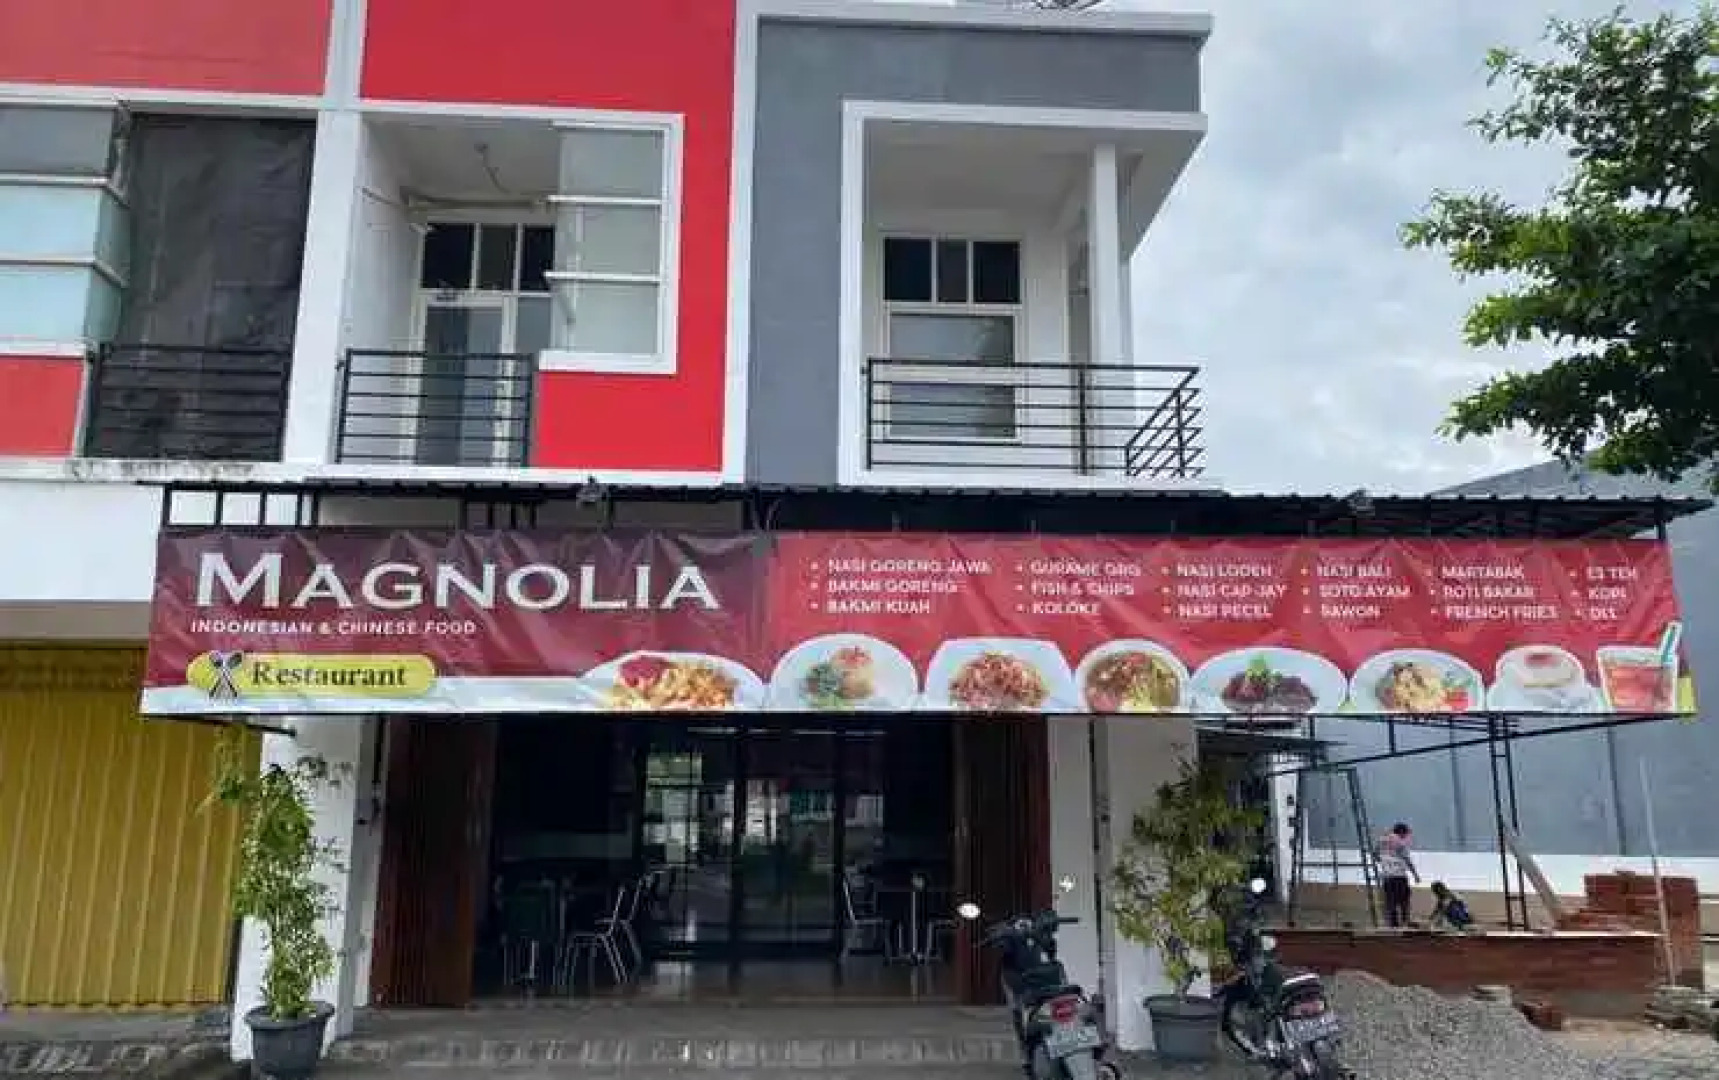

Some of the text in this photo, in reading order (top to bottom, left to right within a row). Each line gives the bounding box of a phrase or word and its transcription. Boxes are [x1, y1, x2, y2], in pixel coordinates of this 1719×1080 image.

[829, 559, 991, 574] NASI GORENG JAWA
[1177, 564, 1214, 577] NASI
[1317, 564, 1392, 577] NASI BALI
[1442, 566, 1525, 579] MARTABAK
[196, 551, 720, 611] MAGNOLIA
[828, 580, 958, 593] BAKMI GORENG
[1031, 582, 1134, 595] FISH & CHIPS
[1177, 584, 1287, 598] NASI CAP JAY
[1319, 585, 1411, 598] SOTO AYAM
[1443, 586, 1534, 598] ROTI BAKAR
[827, 600, 930, 613] BAKMI KUAH
[1178, 605, 1271, 617] NASI PECEL
[1446, 606, 1558, 619] FRENCH FRIES
[190, 620, 476, 635] INDONESIAN & CHINESE FOOD
[251, 660, 406, 688] Restaurant
